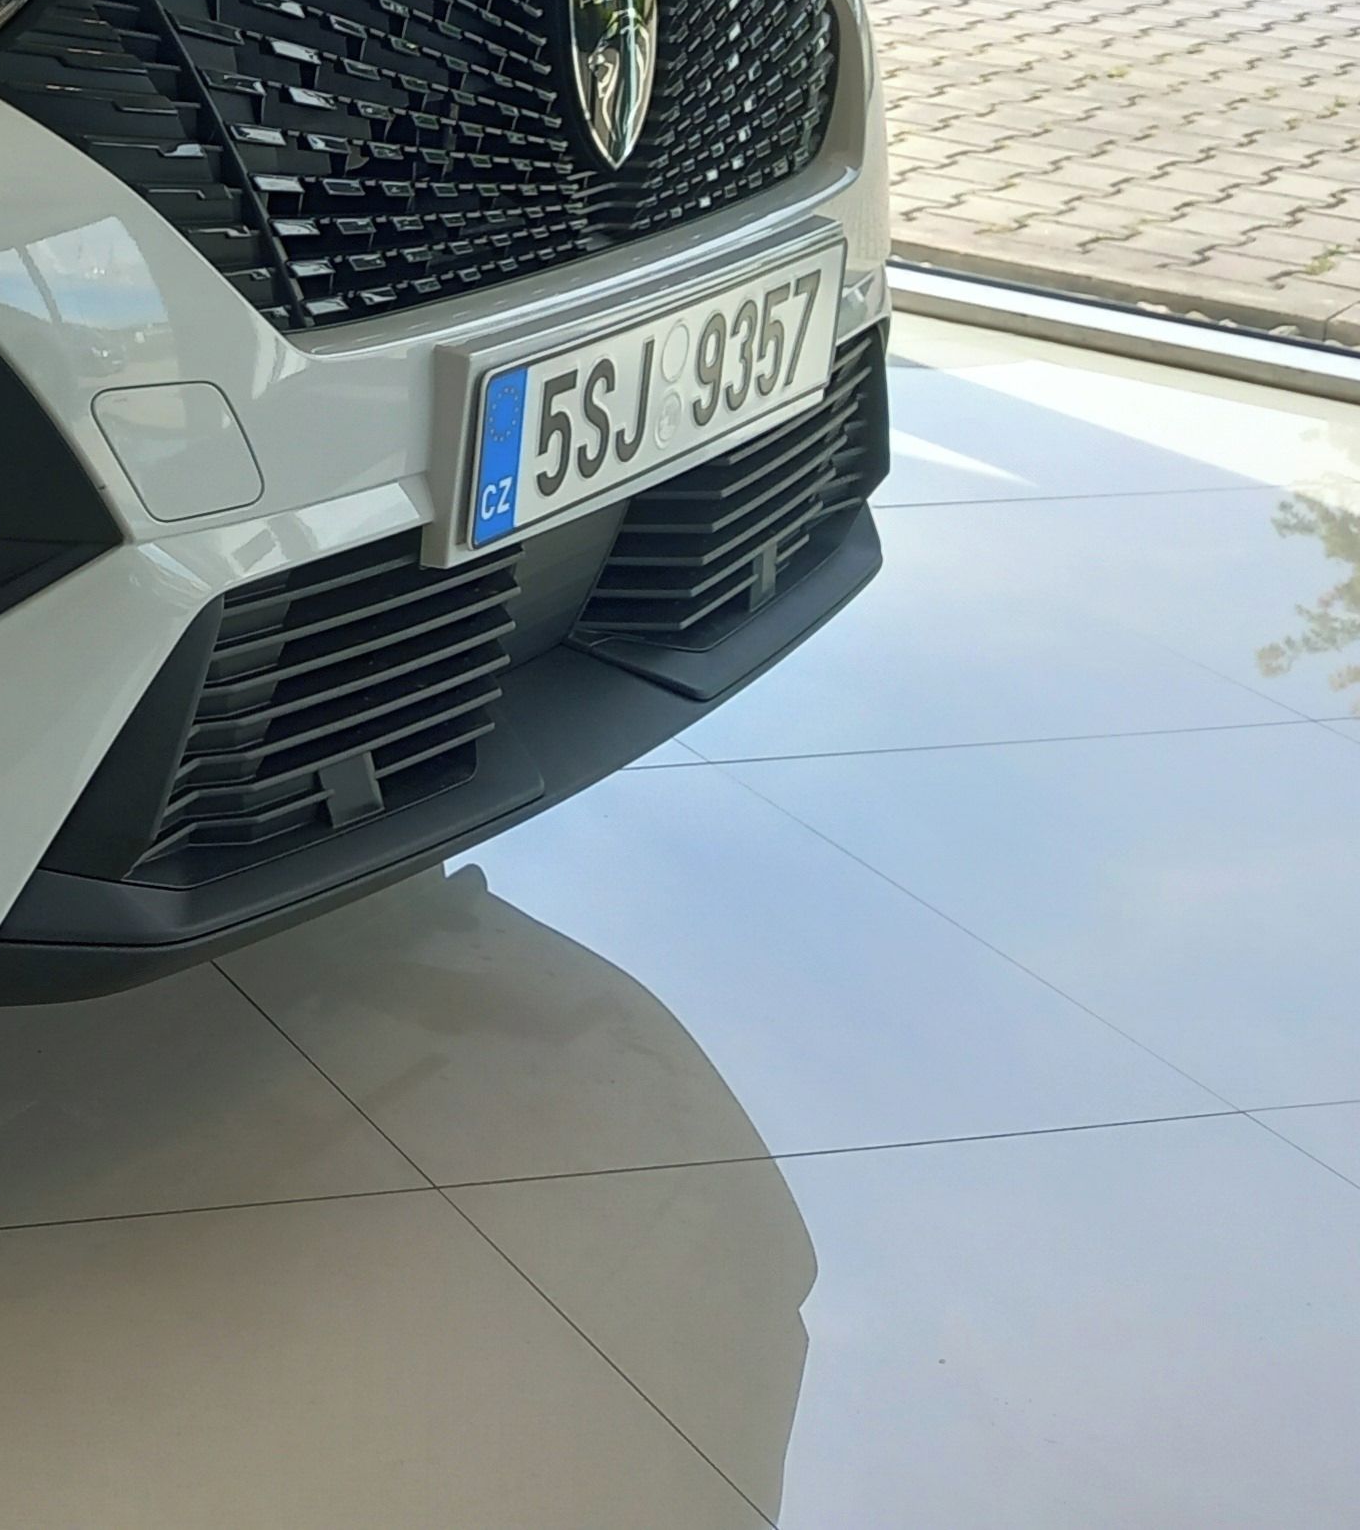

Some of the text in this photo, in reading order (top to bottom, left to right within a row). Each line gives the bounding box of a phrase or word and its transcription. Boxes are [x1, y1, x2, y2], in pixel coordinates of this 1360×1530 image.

[534, 268, 824, 499] 5SJ 9357
[479, 473, 513, 523] CZ
